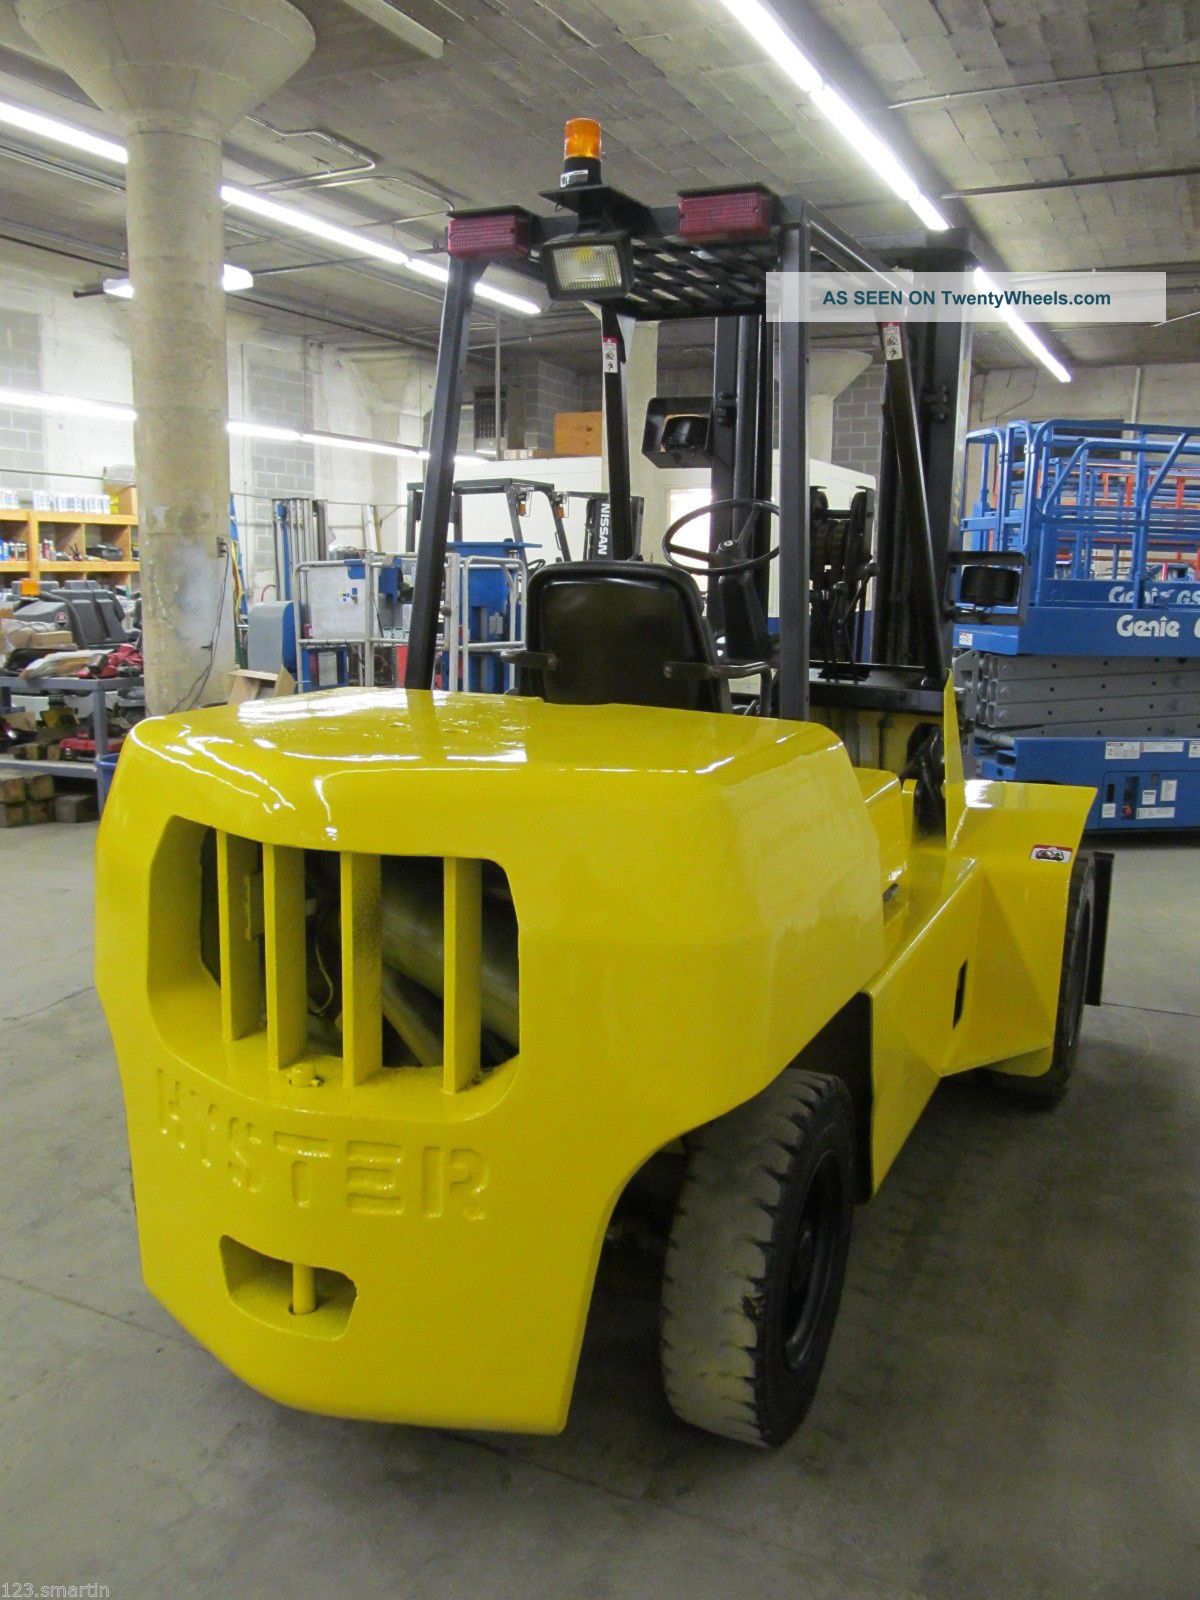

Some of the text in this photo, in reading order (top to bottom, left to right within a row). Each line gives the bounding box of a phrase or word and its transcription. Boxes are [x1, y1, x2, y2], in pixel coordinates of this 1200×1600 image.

[597, 502, 611, 555] NISSAN
[1116, 614, 1180, 638] Genie
[156, 1067, 490, 1223] HYSTER
